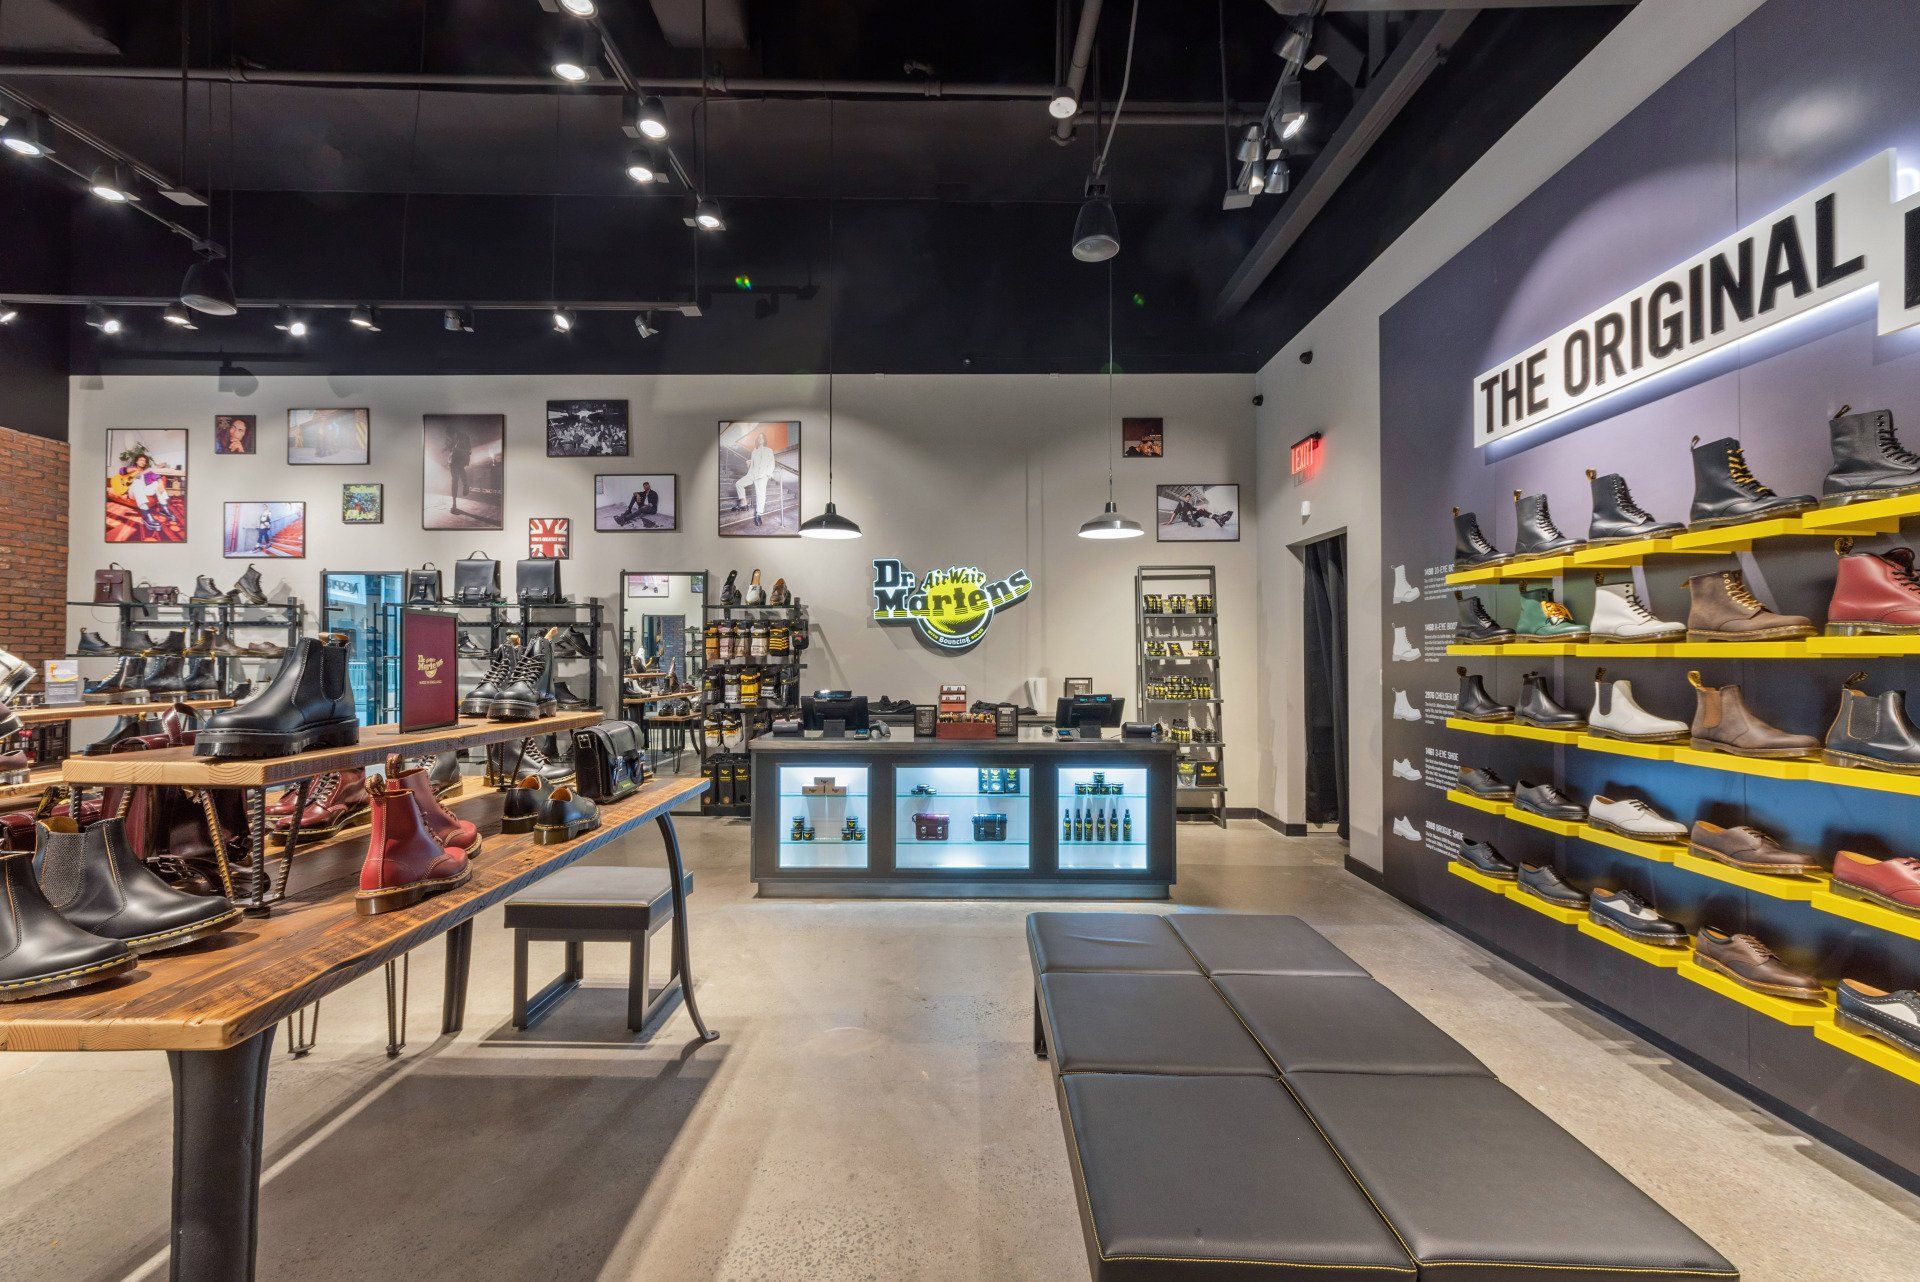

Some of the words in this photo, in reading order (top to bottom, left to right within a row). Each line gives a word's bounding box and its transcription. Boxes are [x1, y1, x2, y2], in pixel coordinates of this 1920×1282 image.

[1480, 347, 1549, 434] THE
[1563, 192, 1866, 397] ORIGINAL
[1295, 441, 1311, 472] EXIT
[873, 560, 915, 588] Dr.
[923, 568, 985, 589] AirWair
[874, 570, 1031, 616] Martens
